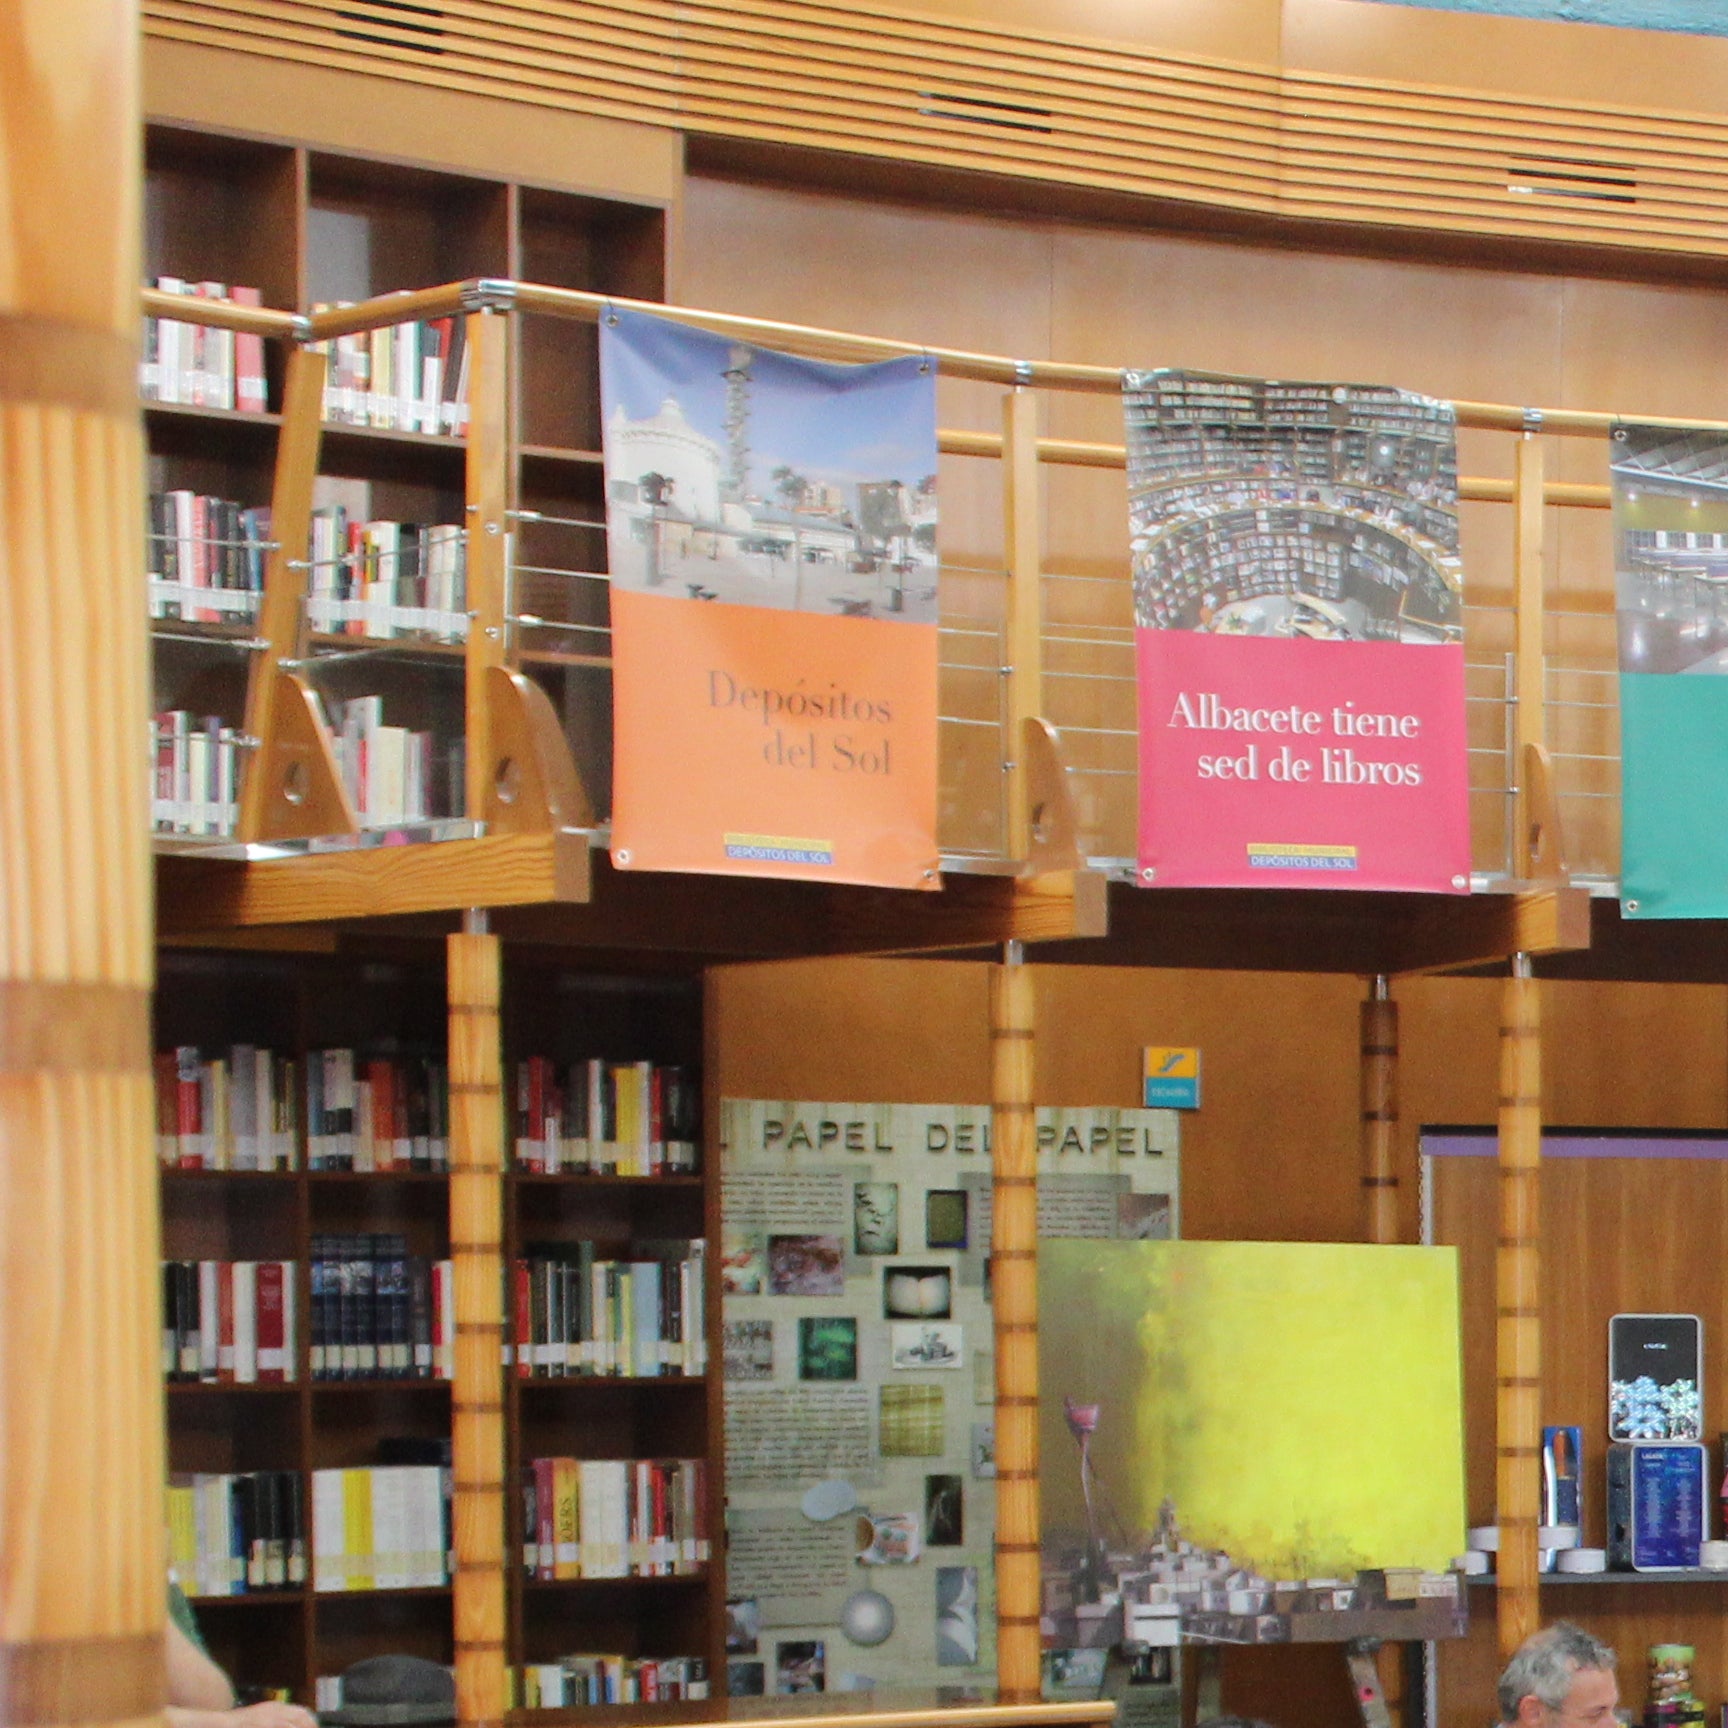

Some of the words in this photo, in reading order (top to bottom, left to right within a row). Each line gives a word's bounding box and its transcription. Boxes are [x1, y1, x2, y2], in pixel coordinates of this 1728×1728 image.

[707, 669, 892, 727] Depósitos
[1167, 692, 1323, 735] Albacete
[1332, 701, 1421, 739] tiene
[762, 729, 817, 769] del
[833, 734, 892, 775] Sol
[1198, 744, 1259, 781] sed
[1269, 746, 1312, 783] de
[1321, 747, 1422, 786] libros
[728, 845, 786, 861] DEPÓSITOS
[787, 851, 807, 862] DEL
[809, 852, 830, 864] SOL
[1251, 855, 1309, 867] DEPÓSITOS
[1311, 857, 1330, 867] DEL
[1333, 857, 1354, 869] SOL
[762, 1120, 894, 1152] PAPEL
[1035, 1124, 1165, 1157] PAPEL
